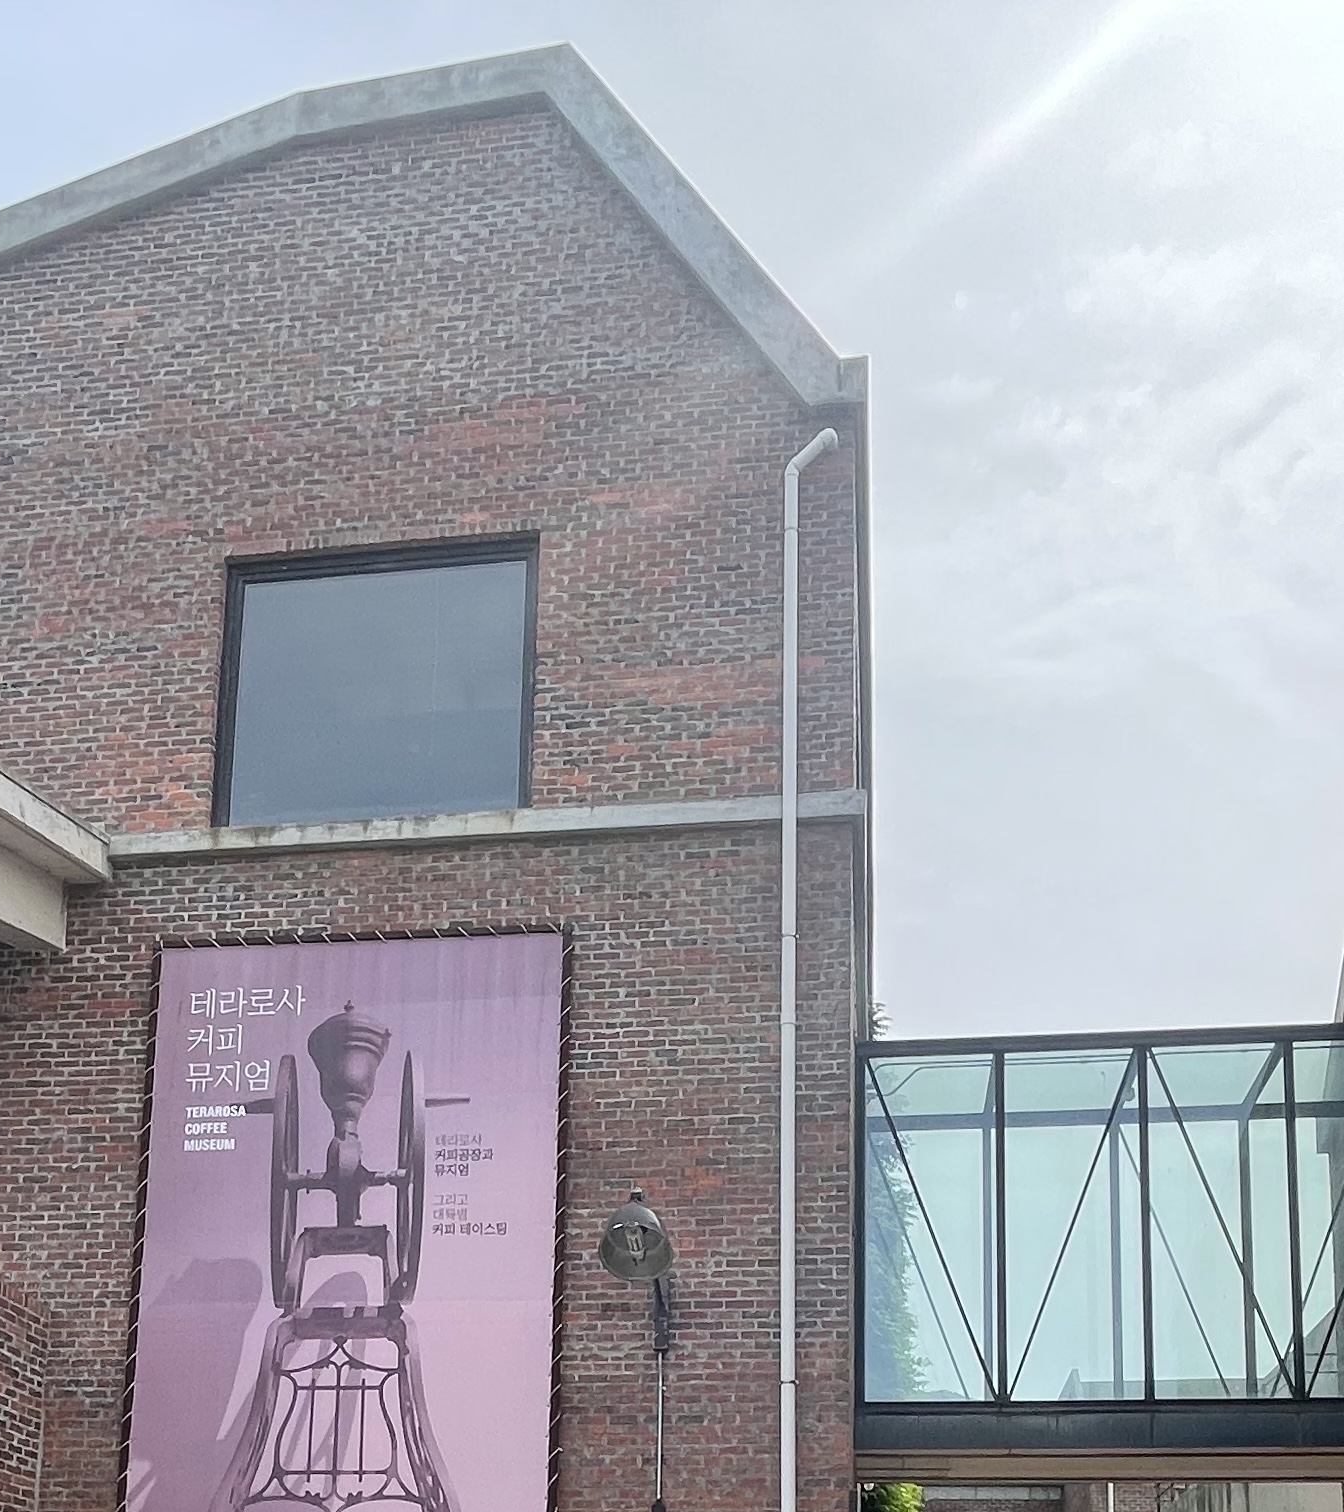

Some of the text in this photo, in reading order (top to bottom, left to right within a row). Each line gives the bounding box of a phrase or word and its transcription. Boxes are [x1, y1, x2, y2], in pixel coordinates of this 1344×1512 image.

[190, 985, 306, 1019] 테라로사
[187, 1024, 243, 1056] 커피
[185, 1059, 271, 1092] 뮤지엄
[185, 1105, 246, 1119] TERAROSA
[185, 1122, 228, 1135] COFFEE
[184, 1138, 235, 1151] MUSEUM
[435, 1148, 494, 1162] 커피공장과
[434, 1163, 469, 1177] 뮤지엄
[433, 1193, 468, 1205] 그리고
[432, 1222, 507, 1236] 커피 테이스팅
